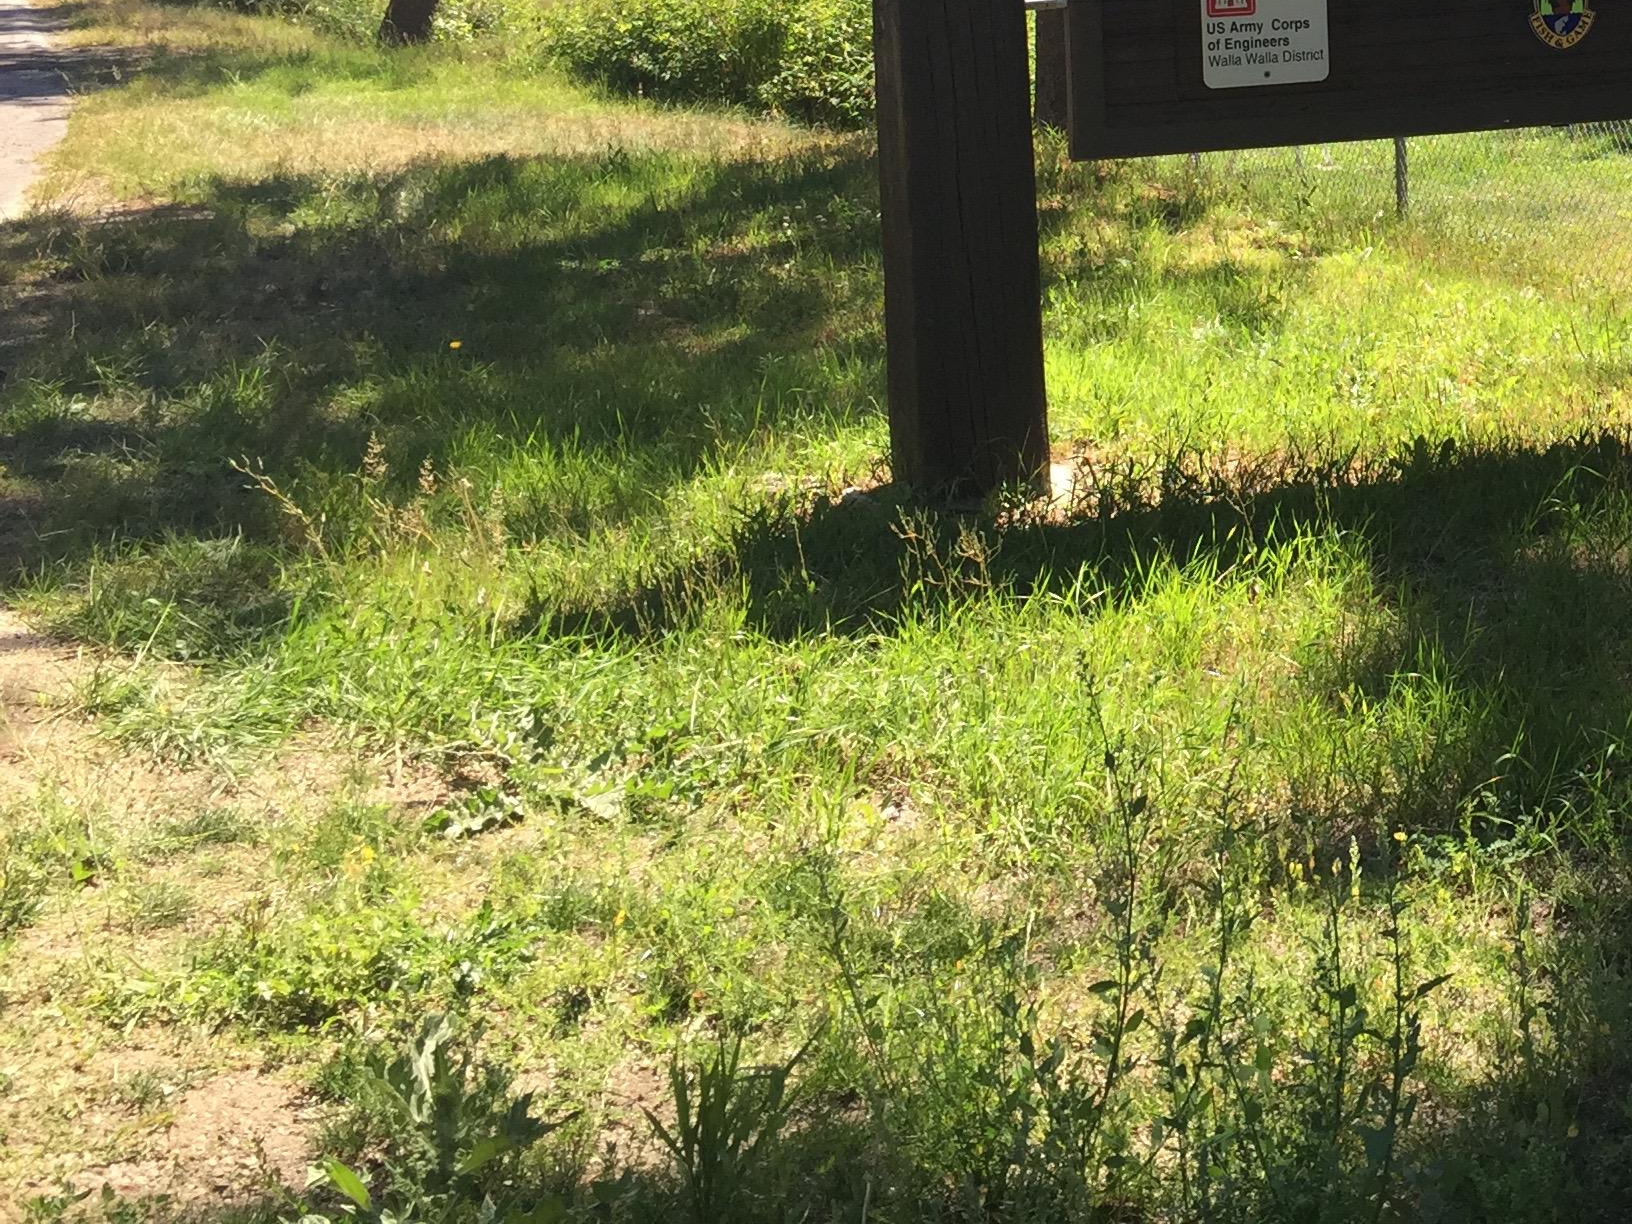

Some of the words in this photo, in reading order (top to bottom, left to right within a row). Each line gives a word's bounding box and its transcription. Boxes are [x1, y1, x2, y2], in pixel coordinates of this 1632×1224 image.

[1206, 21, 1226, 35] US
[1229, 21, 1264, 35] Army
[1271, 18, 1310, 33] Corps
[1532, 16, 1555, 43] FISH
[1555, 37, 1564, 48] &
[1566, 11, 1593, 44] GAME
[1207, 38, 1221, 52] of
[1224, 36, 1290, 52] Engineers
[1208, 53, 1243, 68] Walla
[1245, 51, 1280, 65] Walla
[1282, 49, 1324, 63] District
